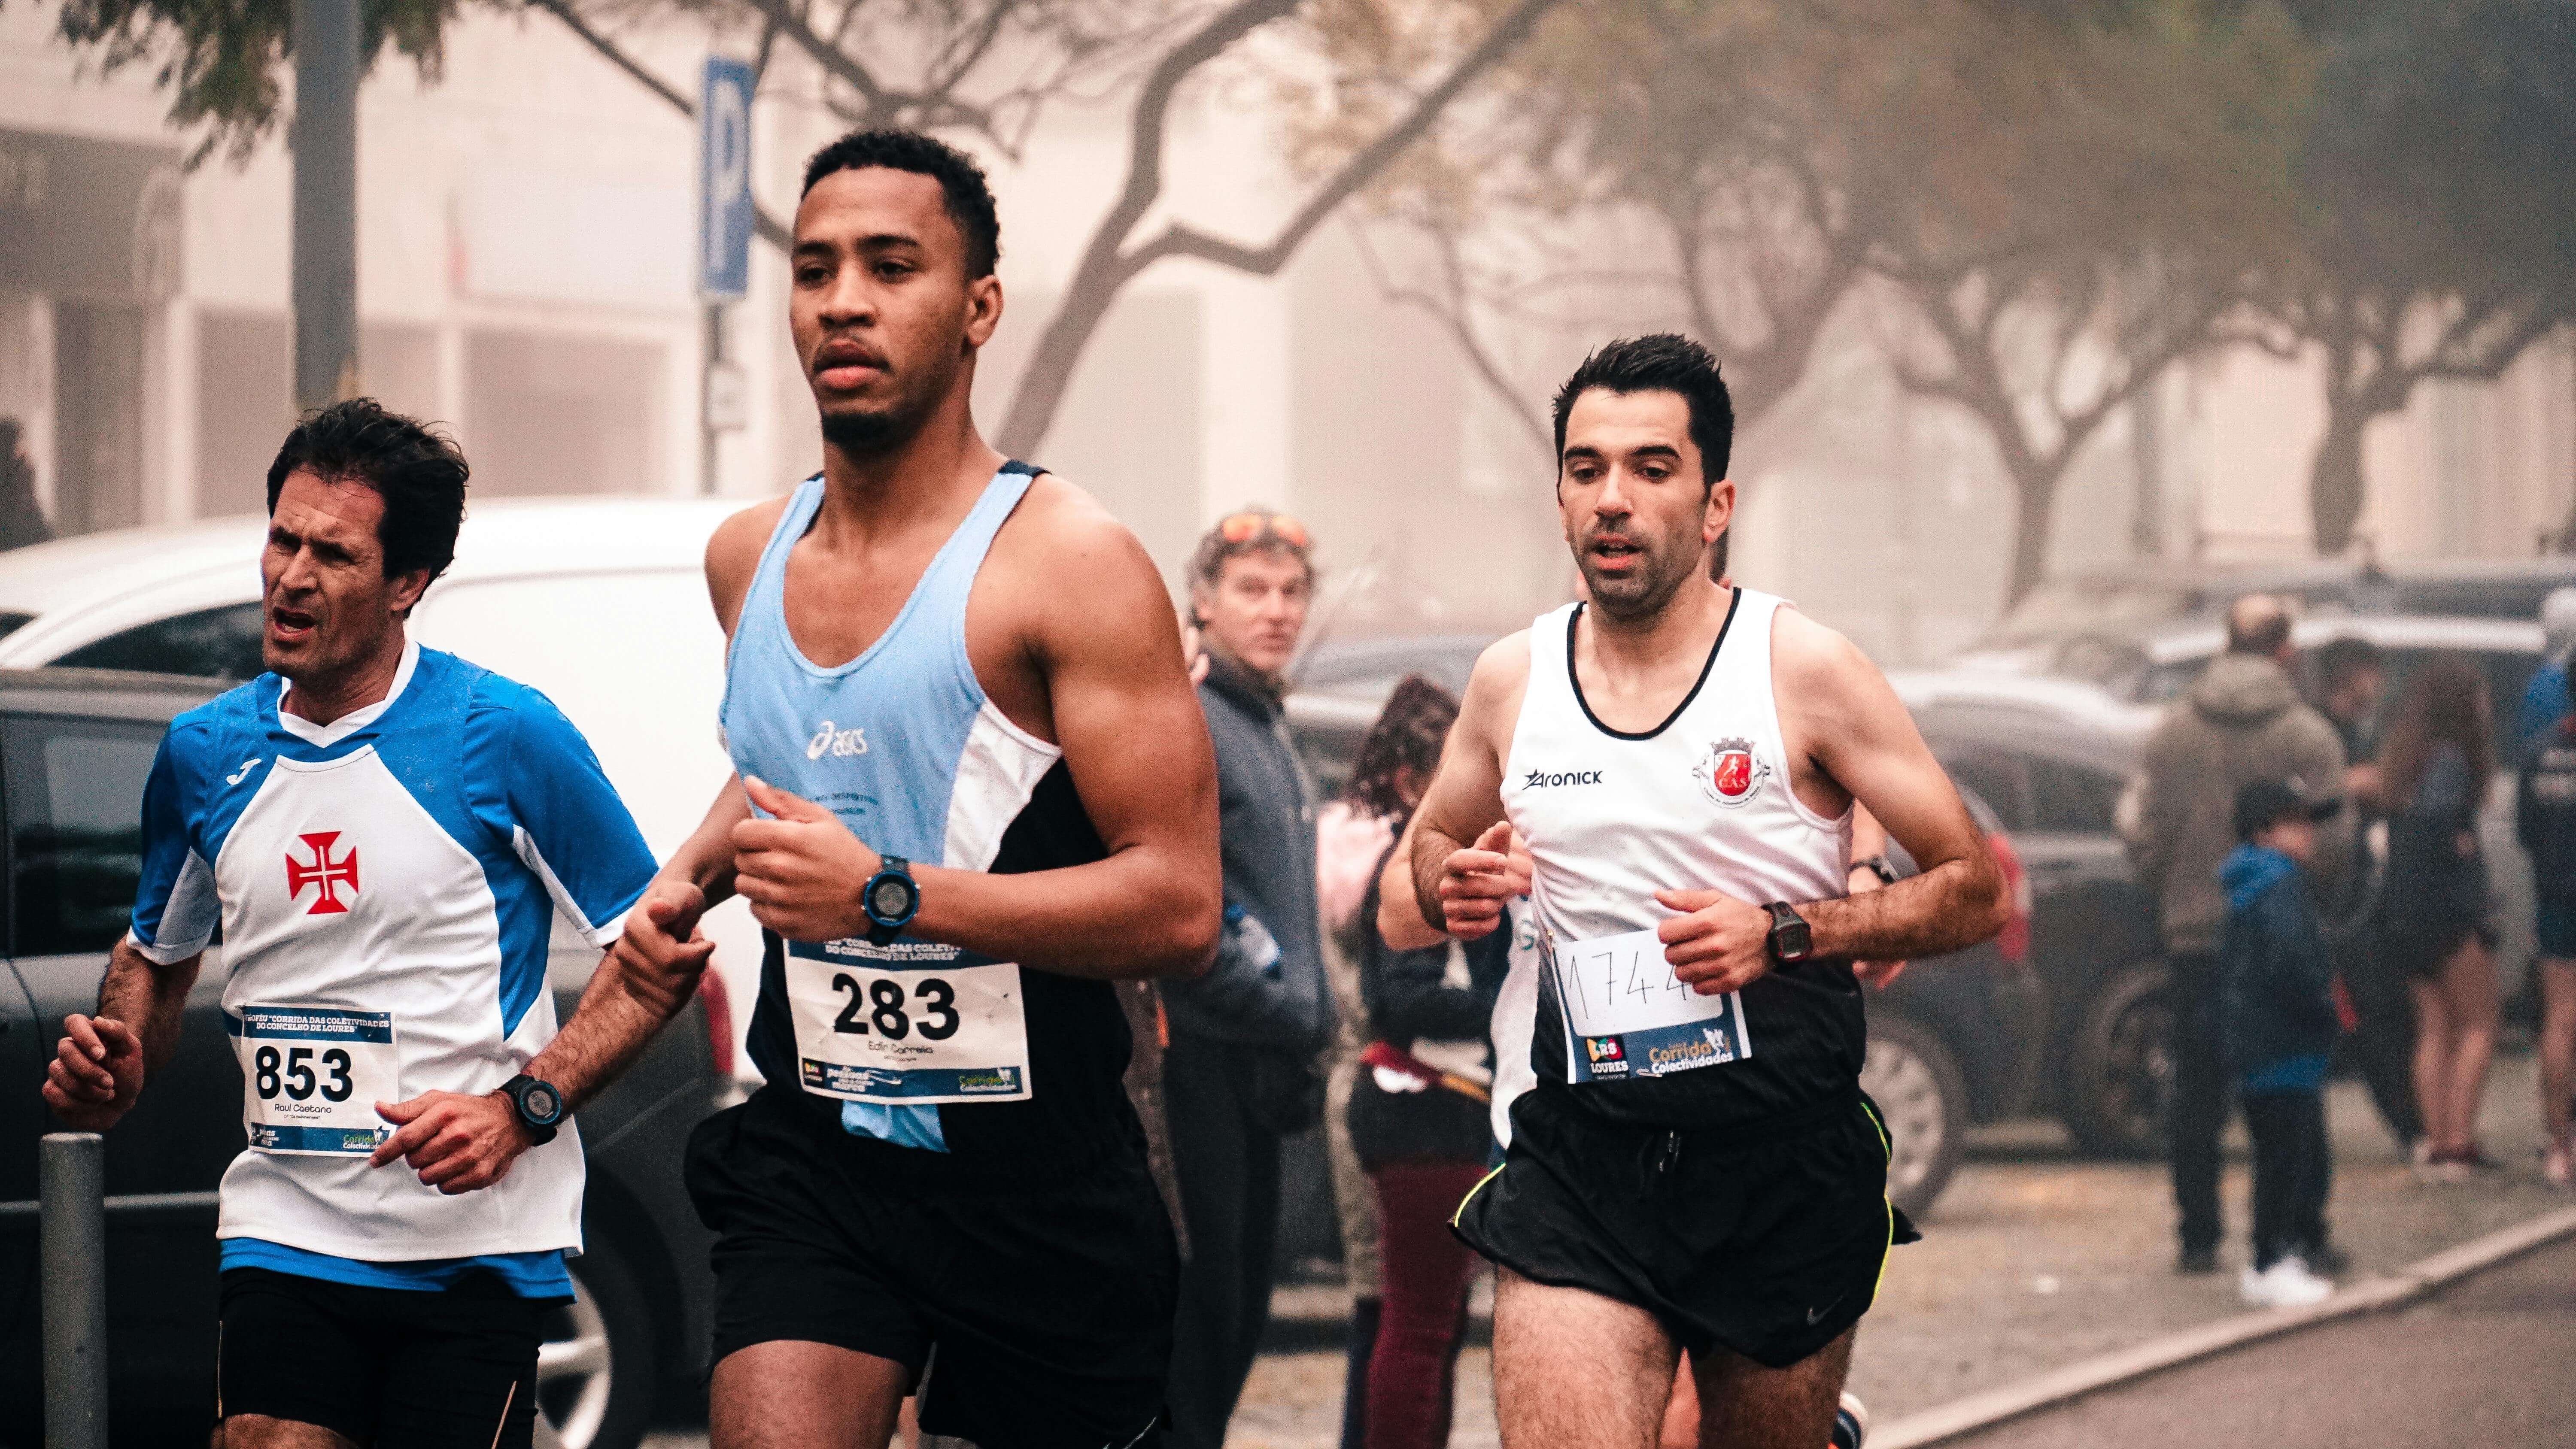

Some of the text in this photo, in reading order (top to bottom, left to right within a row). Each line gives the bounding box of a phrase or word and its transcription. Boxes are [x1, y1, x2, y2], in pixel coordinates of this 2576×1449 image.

[712, 80, 744, 269] P
[832, 973, 960, 1040] 283
[267, 1023, 310, 1031] CONCELHO
[255, 1046, 353, 1102] 853
[1590, 1060, 1628, 1073] LOURES
[274, 1103, 332, 1113] Raul Caetano
